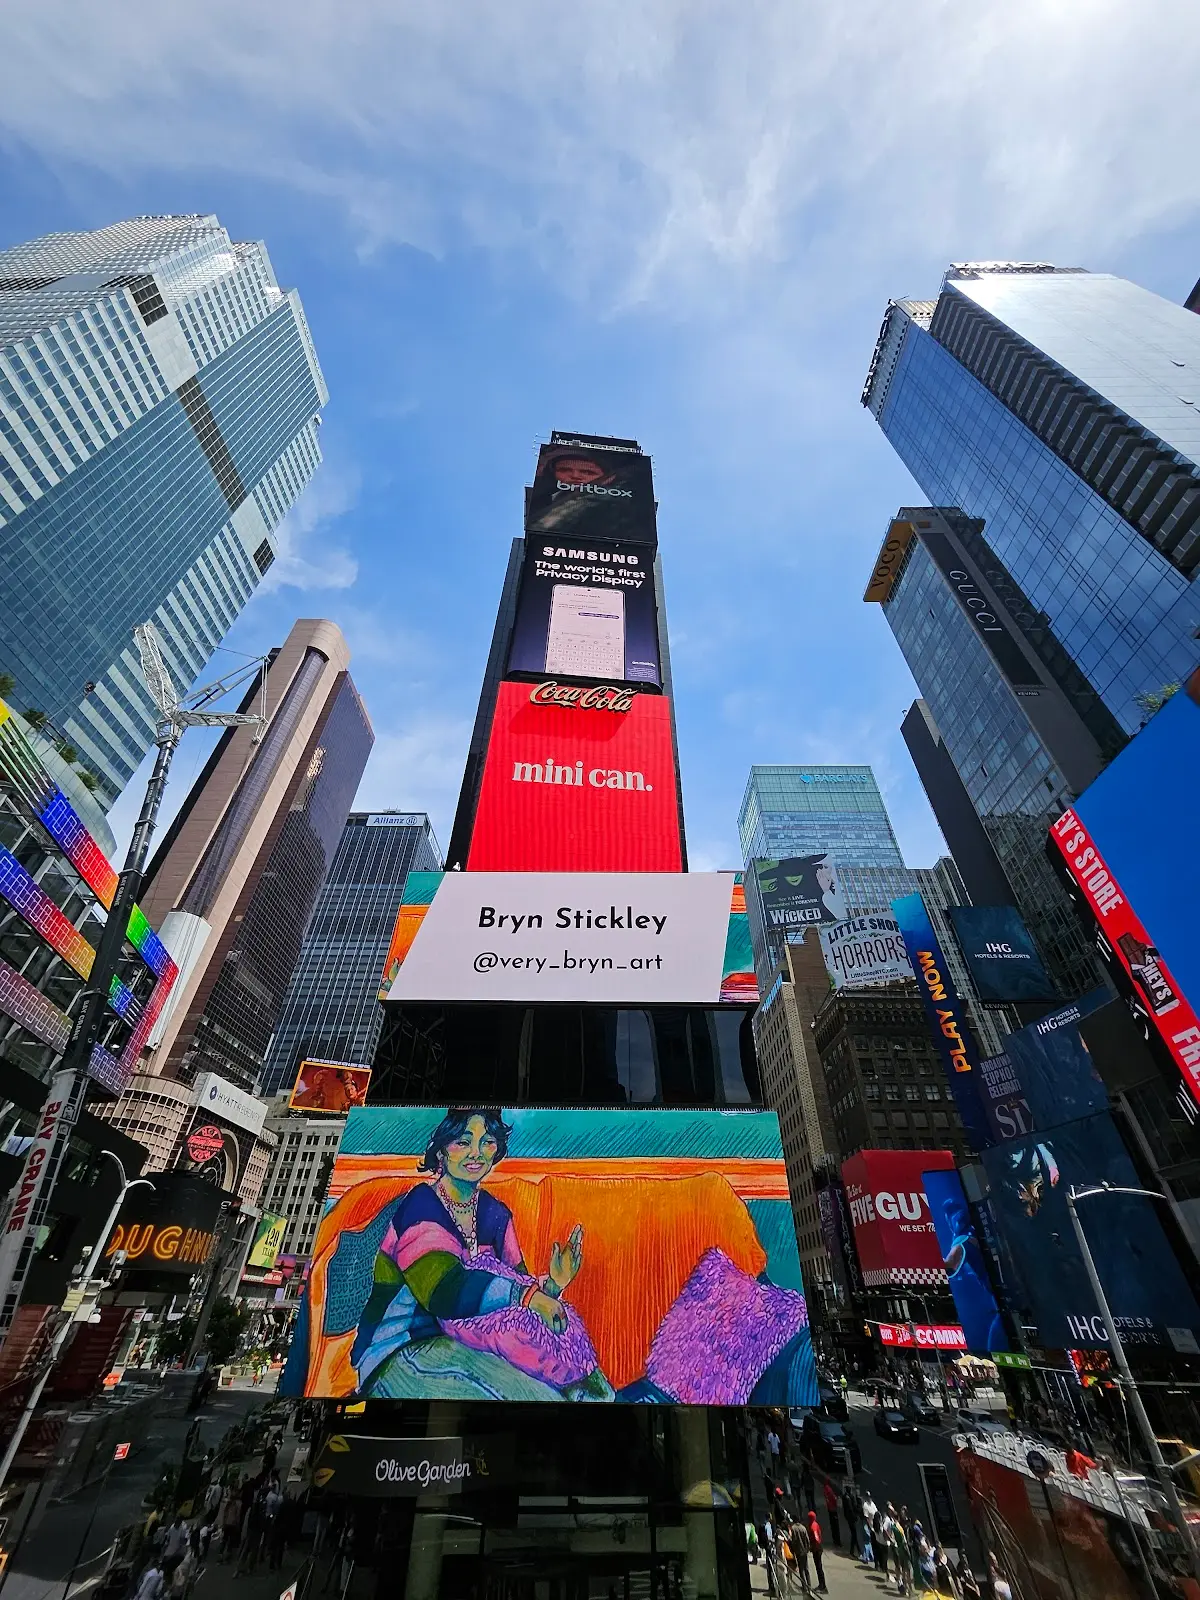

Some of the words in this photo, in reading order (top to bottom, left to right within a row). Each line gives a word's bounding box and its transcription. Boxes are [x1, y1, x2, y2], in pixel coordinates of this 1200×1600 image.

[556, 479, 633, 498] britbox
[542, 546, 639, 565] SAMSUNG
[534, 560, 561, 571] The
[563, 563, 615, 577] world's
[617, 568, 646, 579] first
[535, 568, 589, 583] Privacy
[592, 574, 644, 588] Display
[949, 570, 1003, 632] GUCCI
[511, 758, 584, 787] mini
[588, 768, 654, 792] can.
[813, 774, 868, 784] BARCLAYS
[373, 815, 405, 825] Allianz
[1075, 846, 1124, 917] STORE
[478, 907, 543, 933] Bryn
[555, 907, 668, 934] Stickley
[827, 918, 868, 945] LITTLE
[985, 943, 1012, 953] IHG
[472, 950, 663, 974] @very_bryn_art
[916, 951, 948, 1002] NOW
[1037, 1016, 1058, 1035] IHG
[1056, 1008, 1074, 1021] HOTELS
[1058, 1012, 1081, 1027] RESORTS
[936, 1008, 972, 1073] PLAY
[217, 1093, 238, 1109] HYATT
[237, 1103, 261, 1124] REGENCY
[38, 1101, 62, 1140] BAY
[202, 1127, 218, 1138] HOT
[6, 1148, 46, 1235] CRANE
[850, 1193, 876, 1228] FIVE
[899, 1224, 911, 1233] WE
[911, 1224, 926, 1233] SET
[915, 1328, 966, 1345] COMIN
[1066, 1314, 1110, 1342] IHG
[1112, 1315, 1146, 1329] OTELS
[1117, 1331, 1161, 1345] ESORTS
[375, 1458, 416, 1482] Olive
[417, 1457, 473, 1488] Garden
